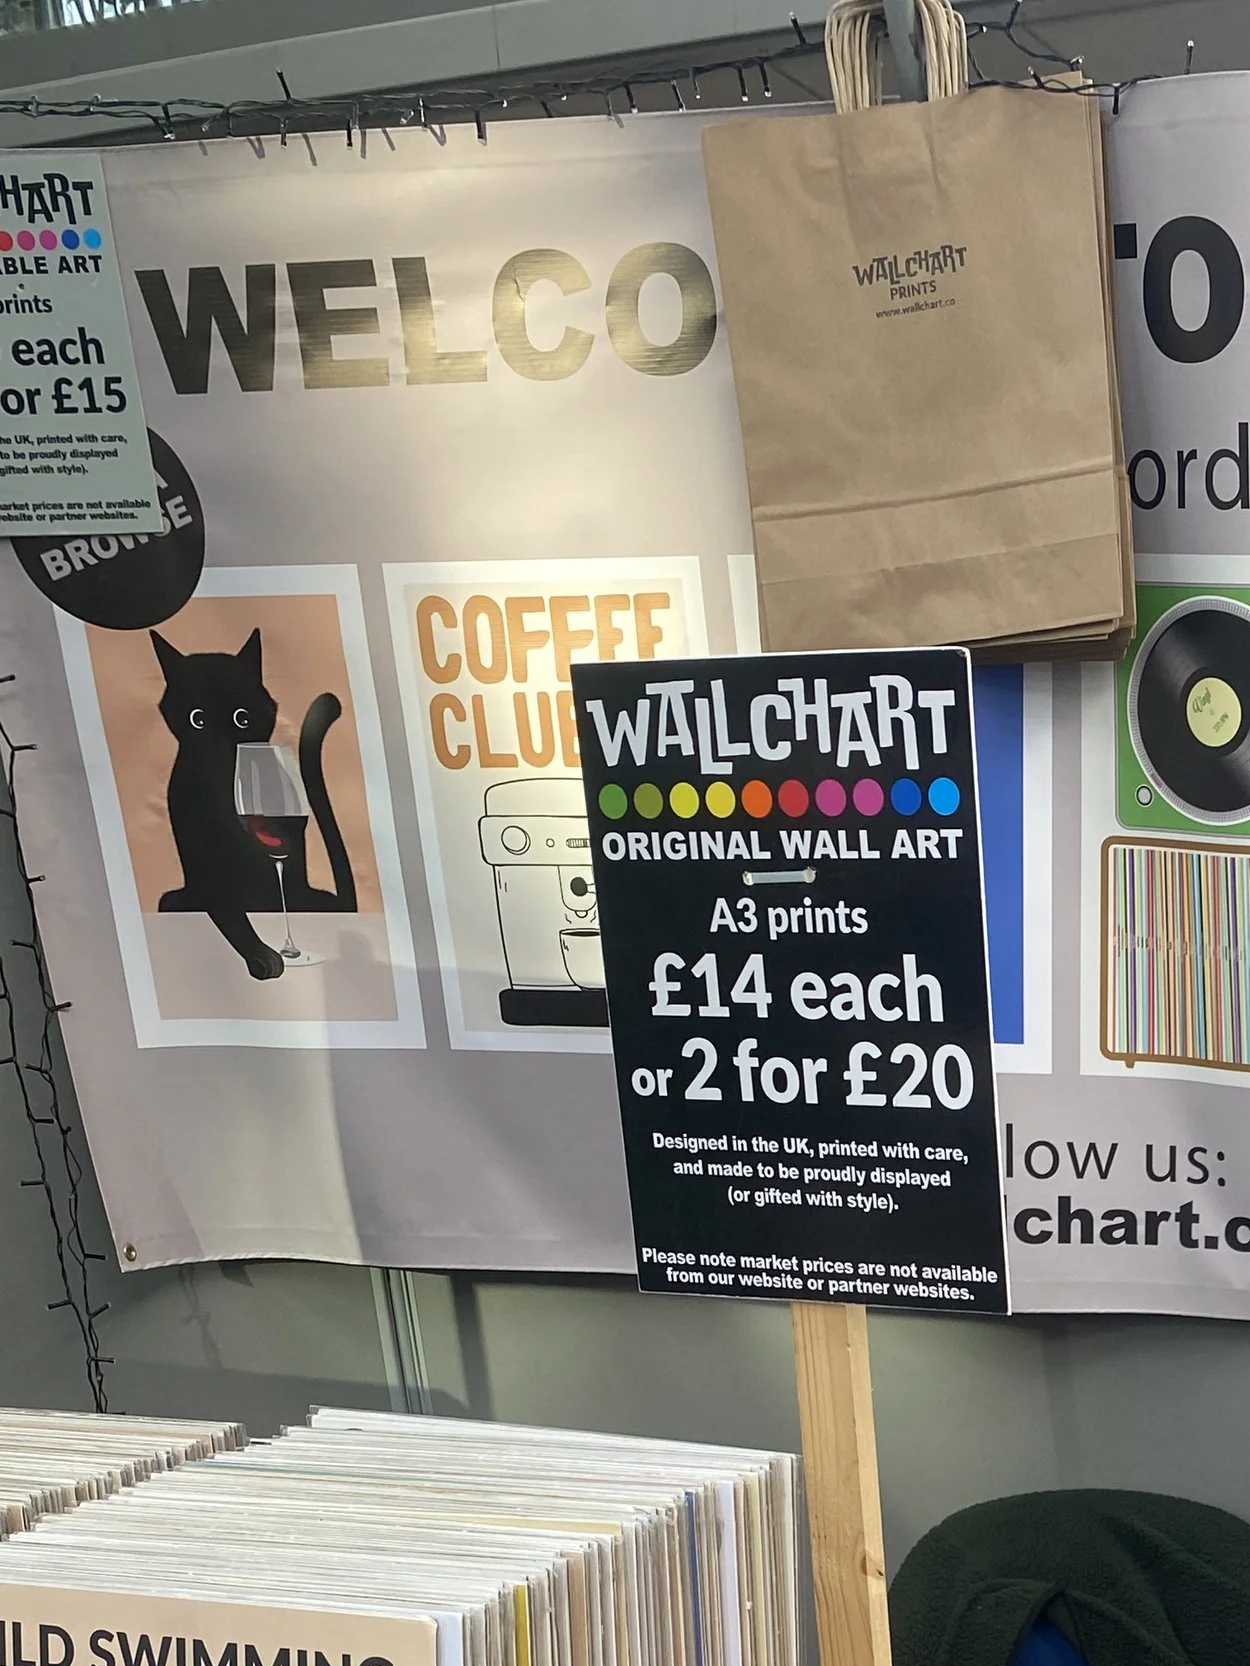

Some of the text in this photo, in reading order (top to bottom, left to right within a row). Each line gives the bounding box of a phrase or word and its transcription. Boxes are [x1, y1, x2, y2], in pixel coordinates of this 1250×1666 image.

[58, 255, 102, 273] ART
[852, 245, 967, 286] WALLCHART
[890, 280, 937, 300] PRINTS
[134, 241, 718, 395] WELCO
[876, 298, 956, 318] www.wallchart.co
[12, 327, 105, 365] each
[52, 377, 126, 413] £15
[29, 449, 118, 461] proudly displayed
[586, 675, 955, 775] WALLCHART
[602, 829, 963, 860] ORIGINAL WALL ART
[710, 897, 869, 940] A3 prints
[649, 952, 944, 1022] £14 each
[631, 1037, 974, 1110] or 2 for £20
[652, 1133, 968, 1164] Designed in the UK, printed with care,
[1146, 1143, 1226, 1187] us:
[673, 1160, 951, 1187] and made to be proudly displayed
[728, 1186, 899, 1212] (or gifted with style).
[642, 1248, 998, 1283] Please note market prices are not available
[667, 1267, 974, 1300] from our website or partner websites.
